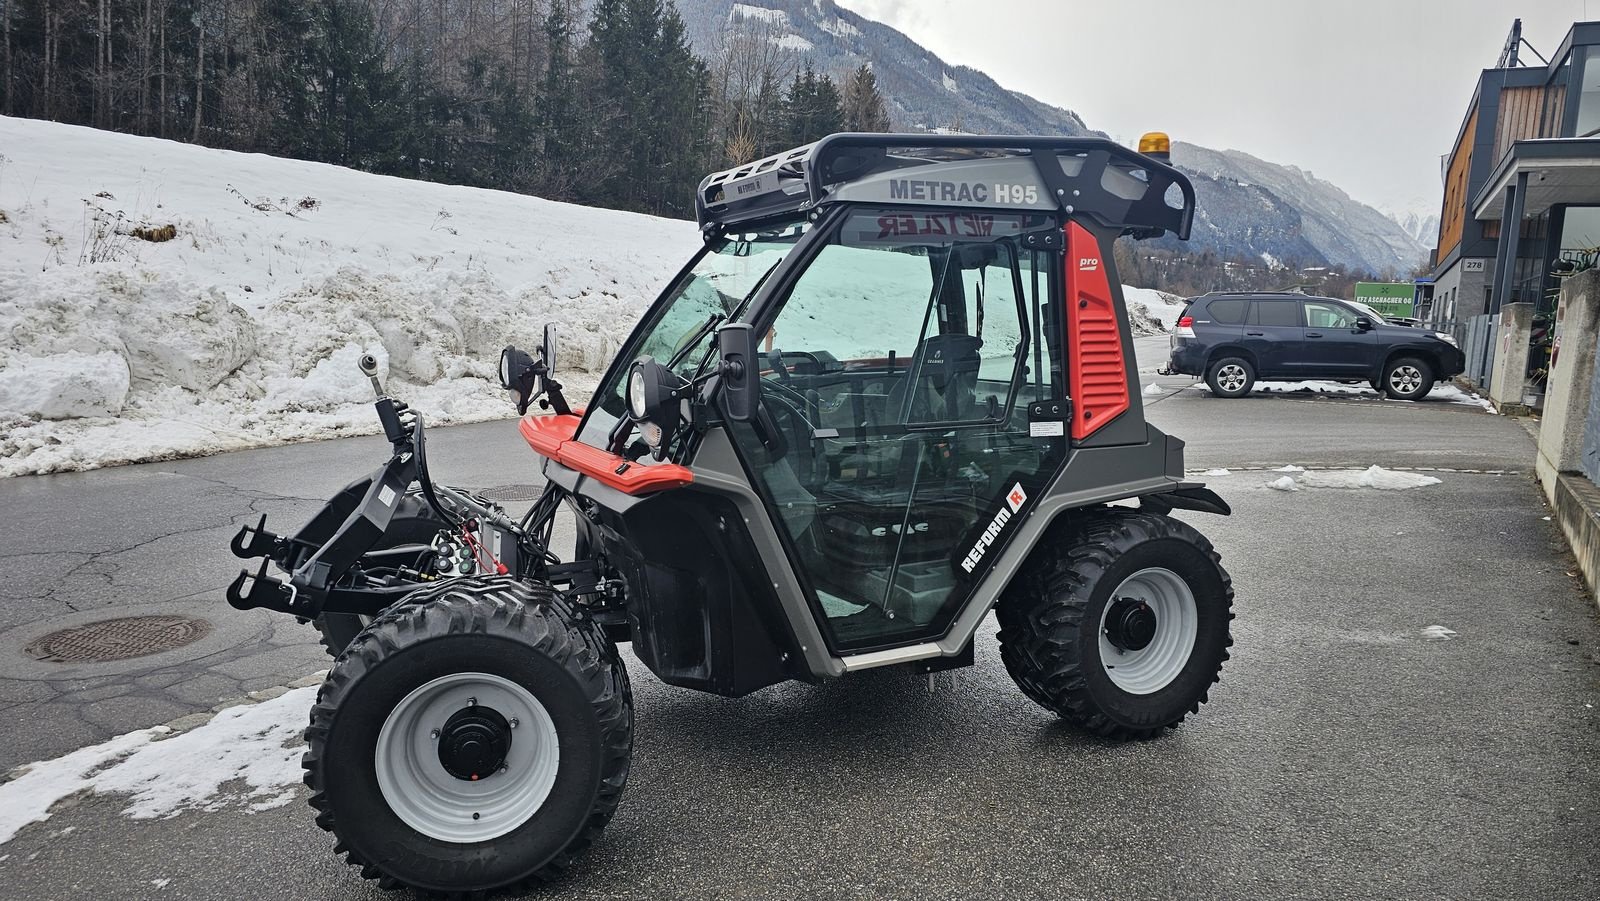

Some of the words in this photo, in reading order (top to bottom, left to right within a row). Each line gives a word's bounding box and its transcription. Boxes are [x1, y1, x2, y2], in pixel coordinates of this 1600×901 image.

[889, 179, 988, 203] METRAC
[994, 183, 1038, 204] H95
[1080, 258, 1098, 267] pro
[1467, 261, 1482, 269] 278
[1368, 296, 1402, 304] ASCHACHER
[960, 506, 1012, 574] REFORM
